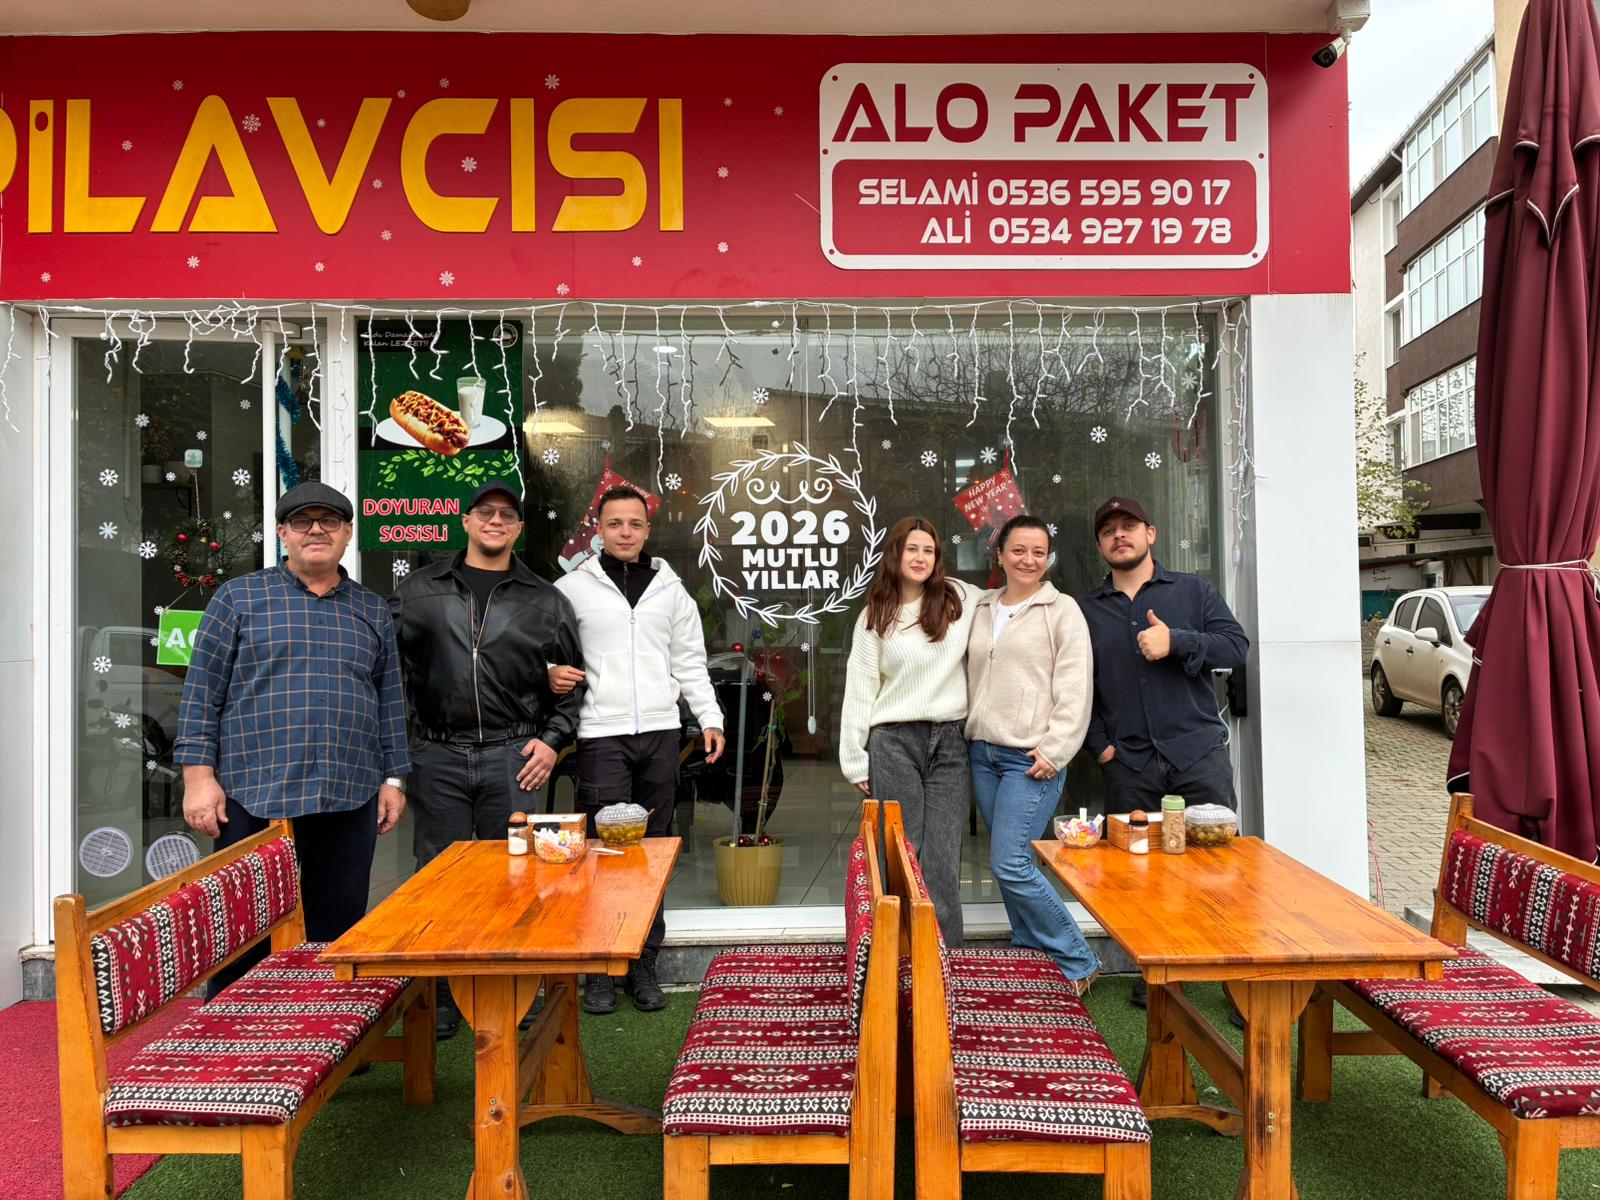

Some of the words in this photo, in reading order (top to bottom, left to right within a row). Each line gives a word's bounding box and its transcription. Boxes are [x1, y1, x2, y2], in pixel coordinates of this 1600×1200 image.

[831, 82, 989, 143] ALO
[1014, 82, 1256, 142] PAKET
[858, 171, 978, 205] SELAMİ
[987, 179, 1071, 205] 0536
[1080, 179, 1141, 205] 595
[1150, 179, 1193, 205] 90
[1201, 179, 1231, 205] 17
[920, 210, 971, 244] ALİ
[989, 217, 1072, 244] 0534
[1080, 217, 1143, 244] 927
[1150, 217, 1182, 244] 19
[1191, 217, 1231, 244] 78
[964, 496, 984, 512] NEW
[985, 482, 1008, 499] YEAR
[968, 476, 996, 498] HAPPY
[363, 498, 460, 515] DOYURAN
[730, 510, 850, 545] 2026
[742, 547, 839, 568] MUTLU
[741, 569, 840, 590] YILLAR
